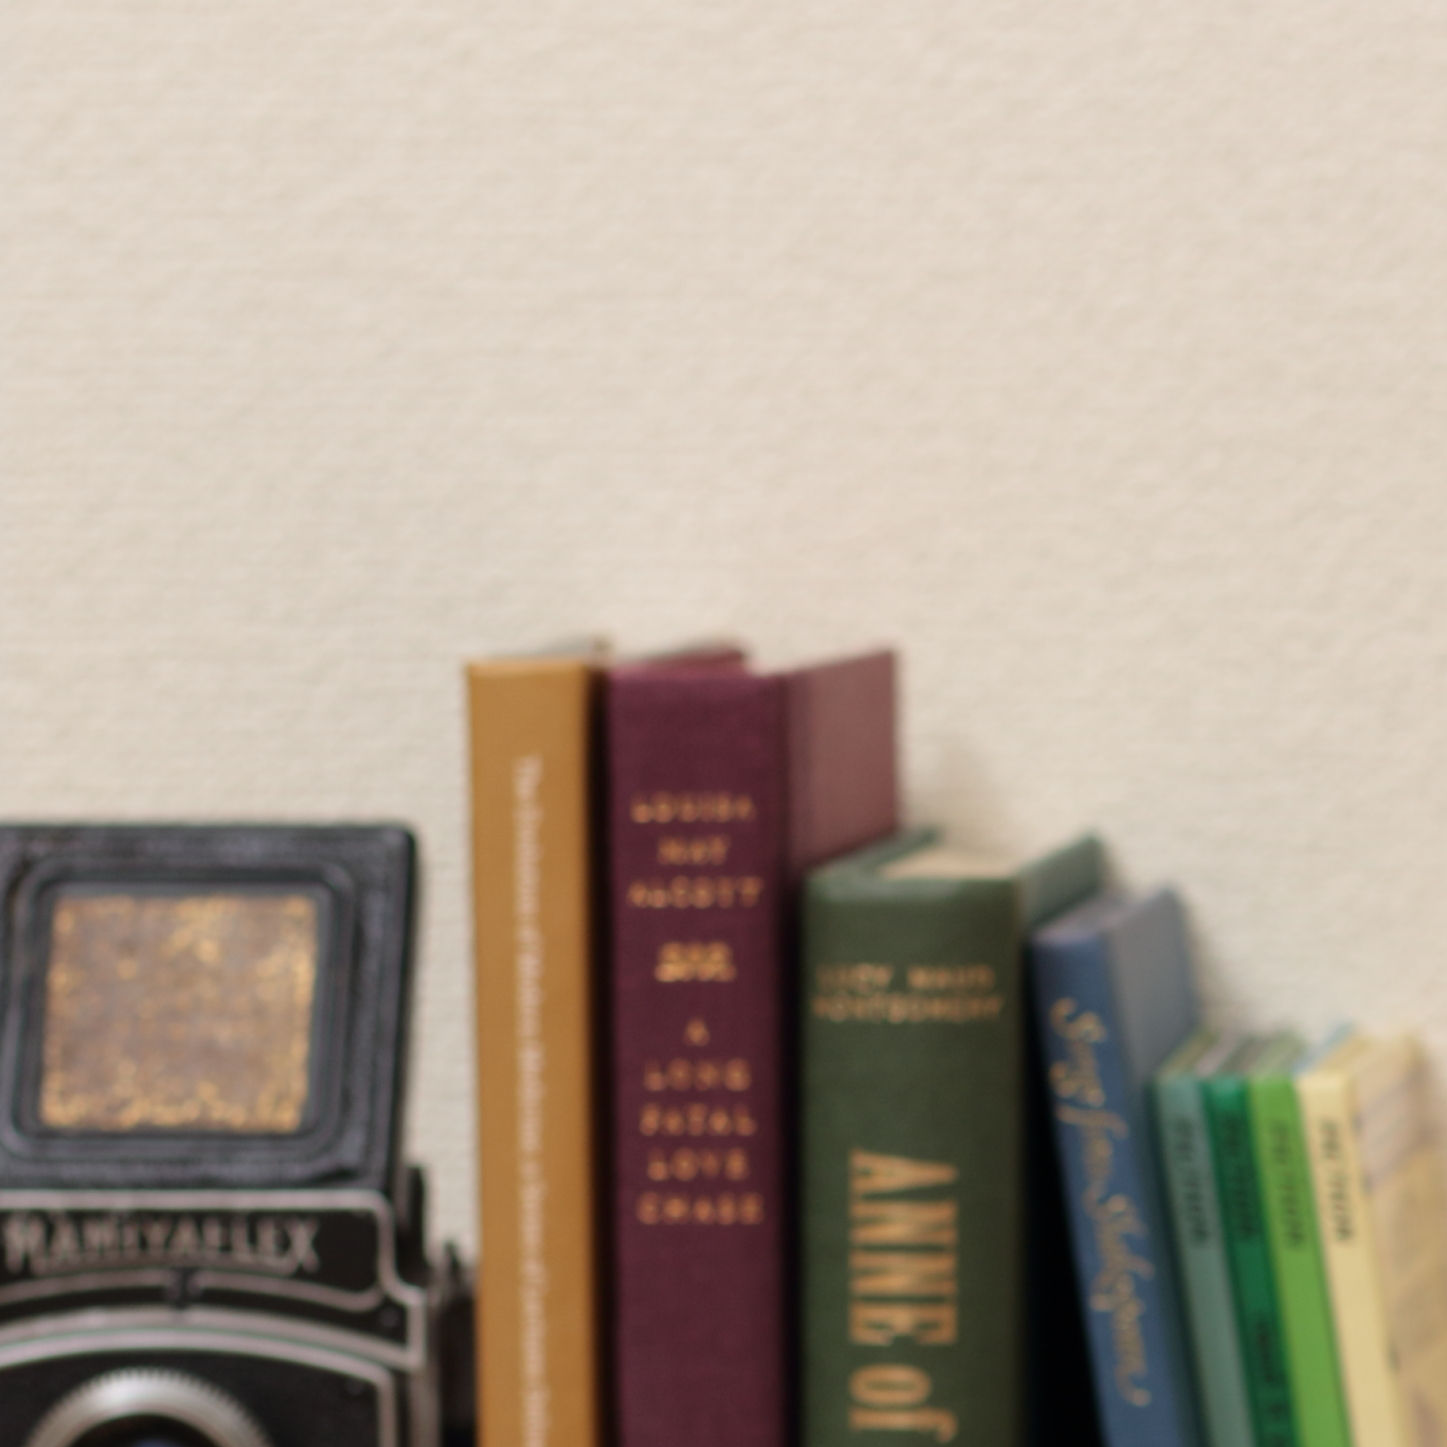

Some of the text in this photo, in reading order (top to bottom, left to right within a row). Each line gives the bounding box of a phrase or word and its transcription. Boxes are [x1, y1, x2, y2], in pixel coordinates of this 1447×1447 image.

[643, 1058, 751, 1092] LONG
[647, 1148, 750, 1182] LOVE
[849, 1150, 958, 1345] ANNE
[848, 1361, 957, 1440] of
